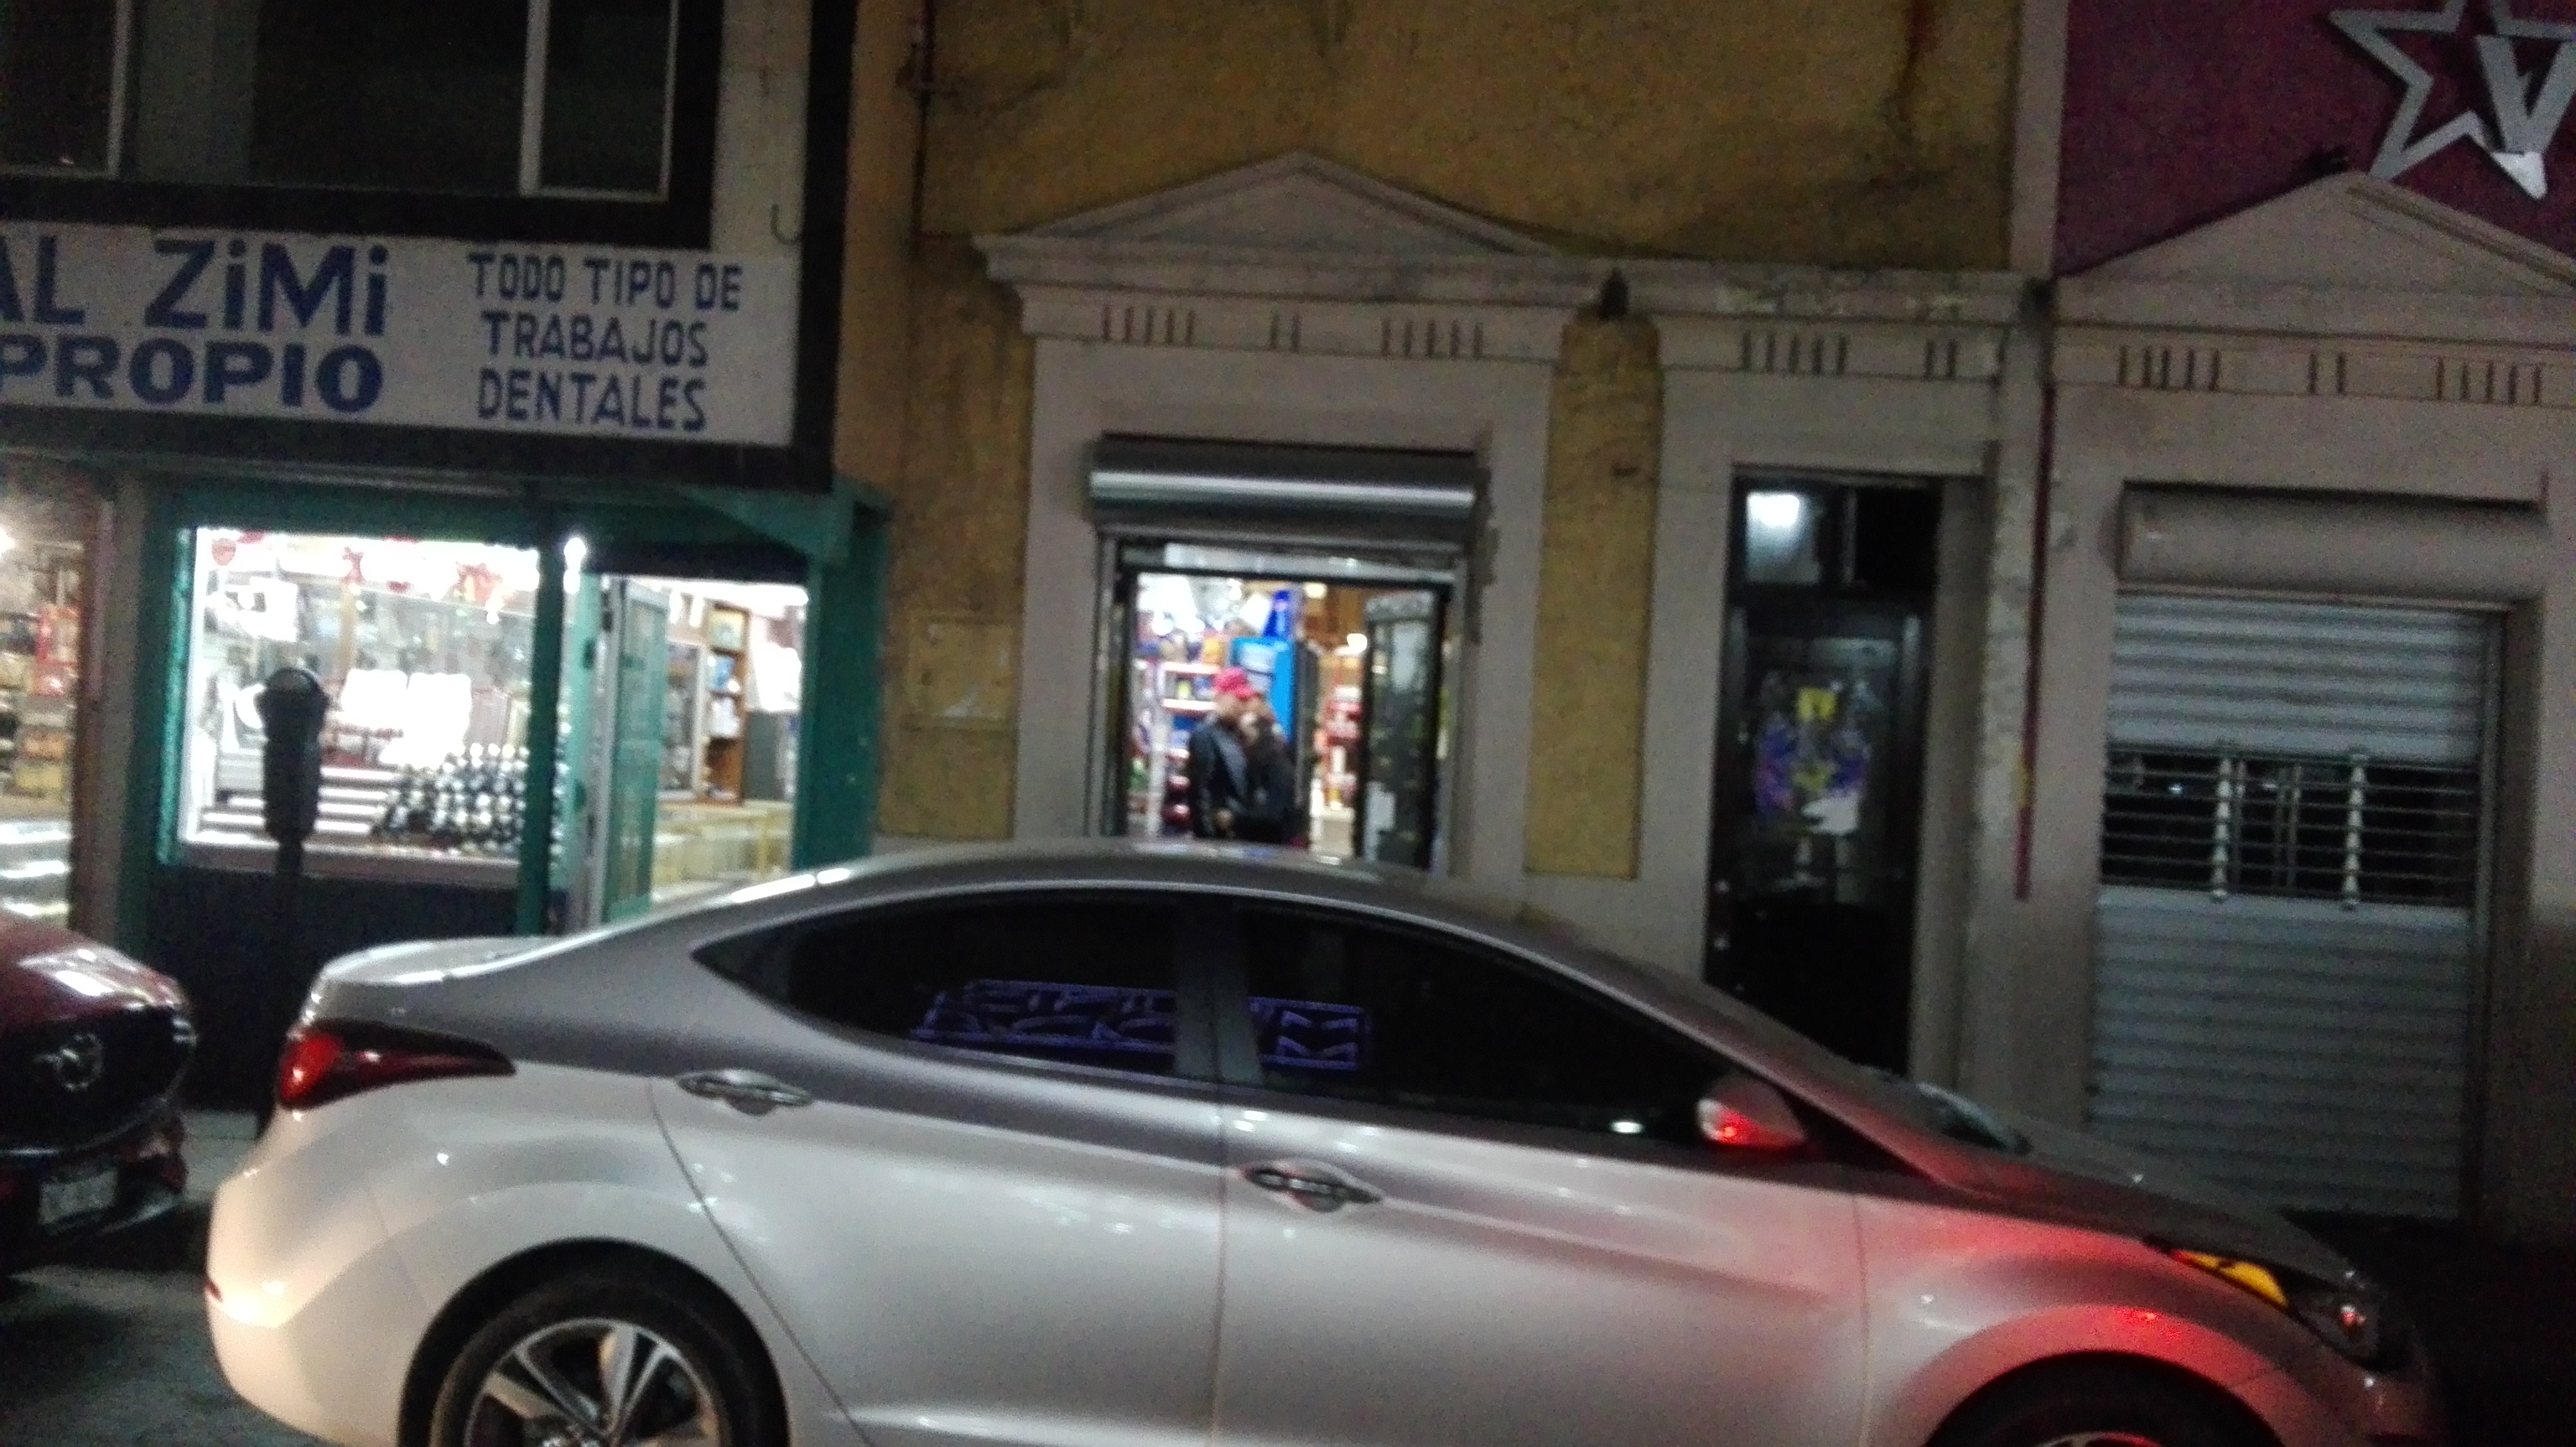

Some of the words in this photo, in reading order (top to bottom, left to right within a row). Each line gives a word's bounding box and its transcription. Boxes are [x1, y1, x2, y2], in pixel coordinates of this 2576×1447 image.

[467, 251, 567, 304] TODO
[582, 256, 676, 310] TIPO
[694, 262, 742, 312] DE
[480, 310, 708, 369] TRABAJOS
[0, 333, 384, 413] PROPIO
[477, 367, 707, 433] DENTALES
